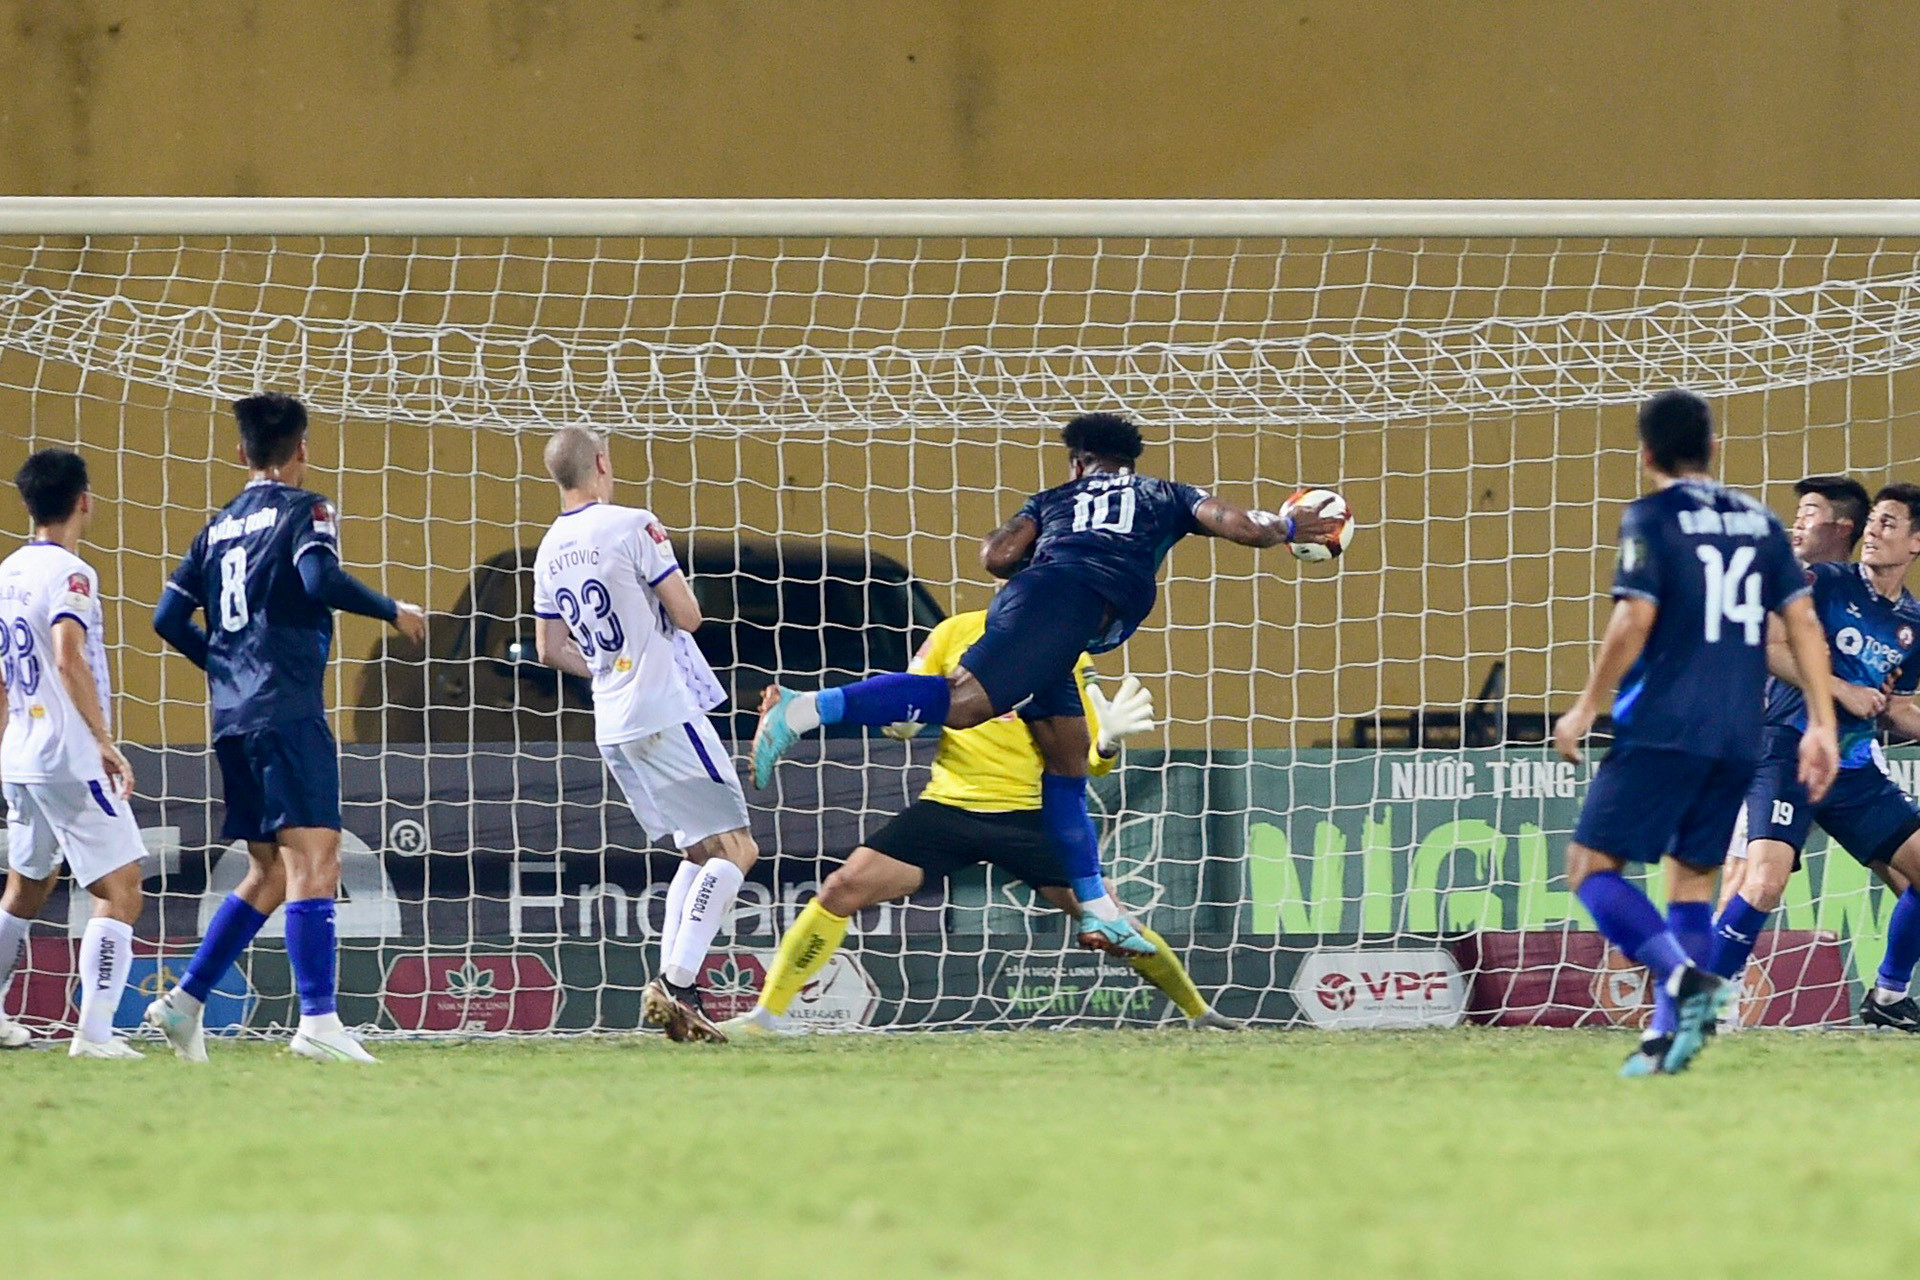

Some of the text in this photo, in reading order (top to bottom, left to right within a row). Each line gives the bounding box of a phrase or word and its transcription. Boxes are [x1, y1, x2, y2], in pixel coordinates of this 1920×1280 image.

[1072, 487, 1135, 534] 10
[219, 545, 250, 633] 8
[555, 578, 625, 658] 33
[1696, 544, 1764, 646] 14
[1485, 756, 1577, 799] TĂNG
[1771, 799, 1795, 826] 19
[1249, 803, 1667, 935] NIGH
[1360, 971, 1448, 1001] VPF
